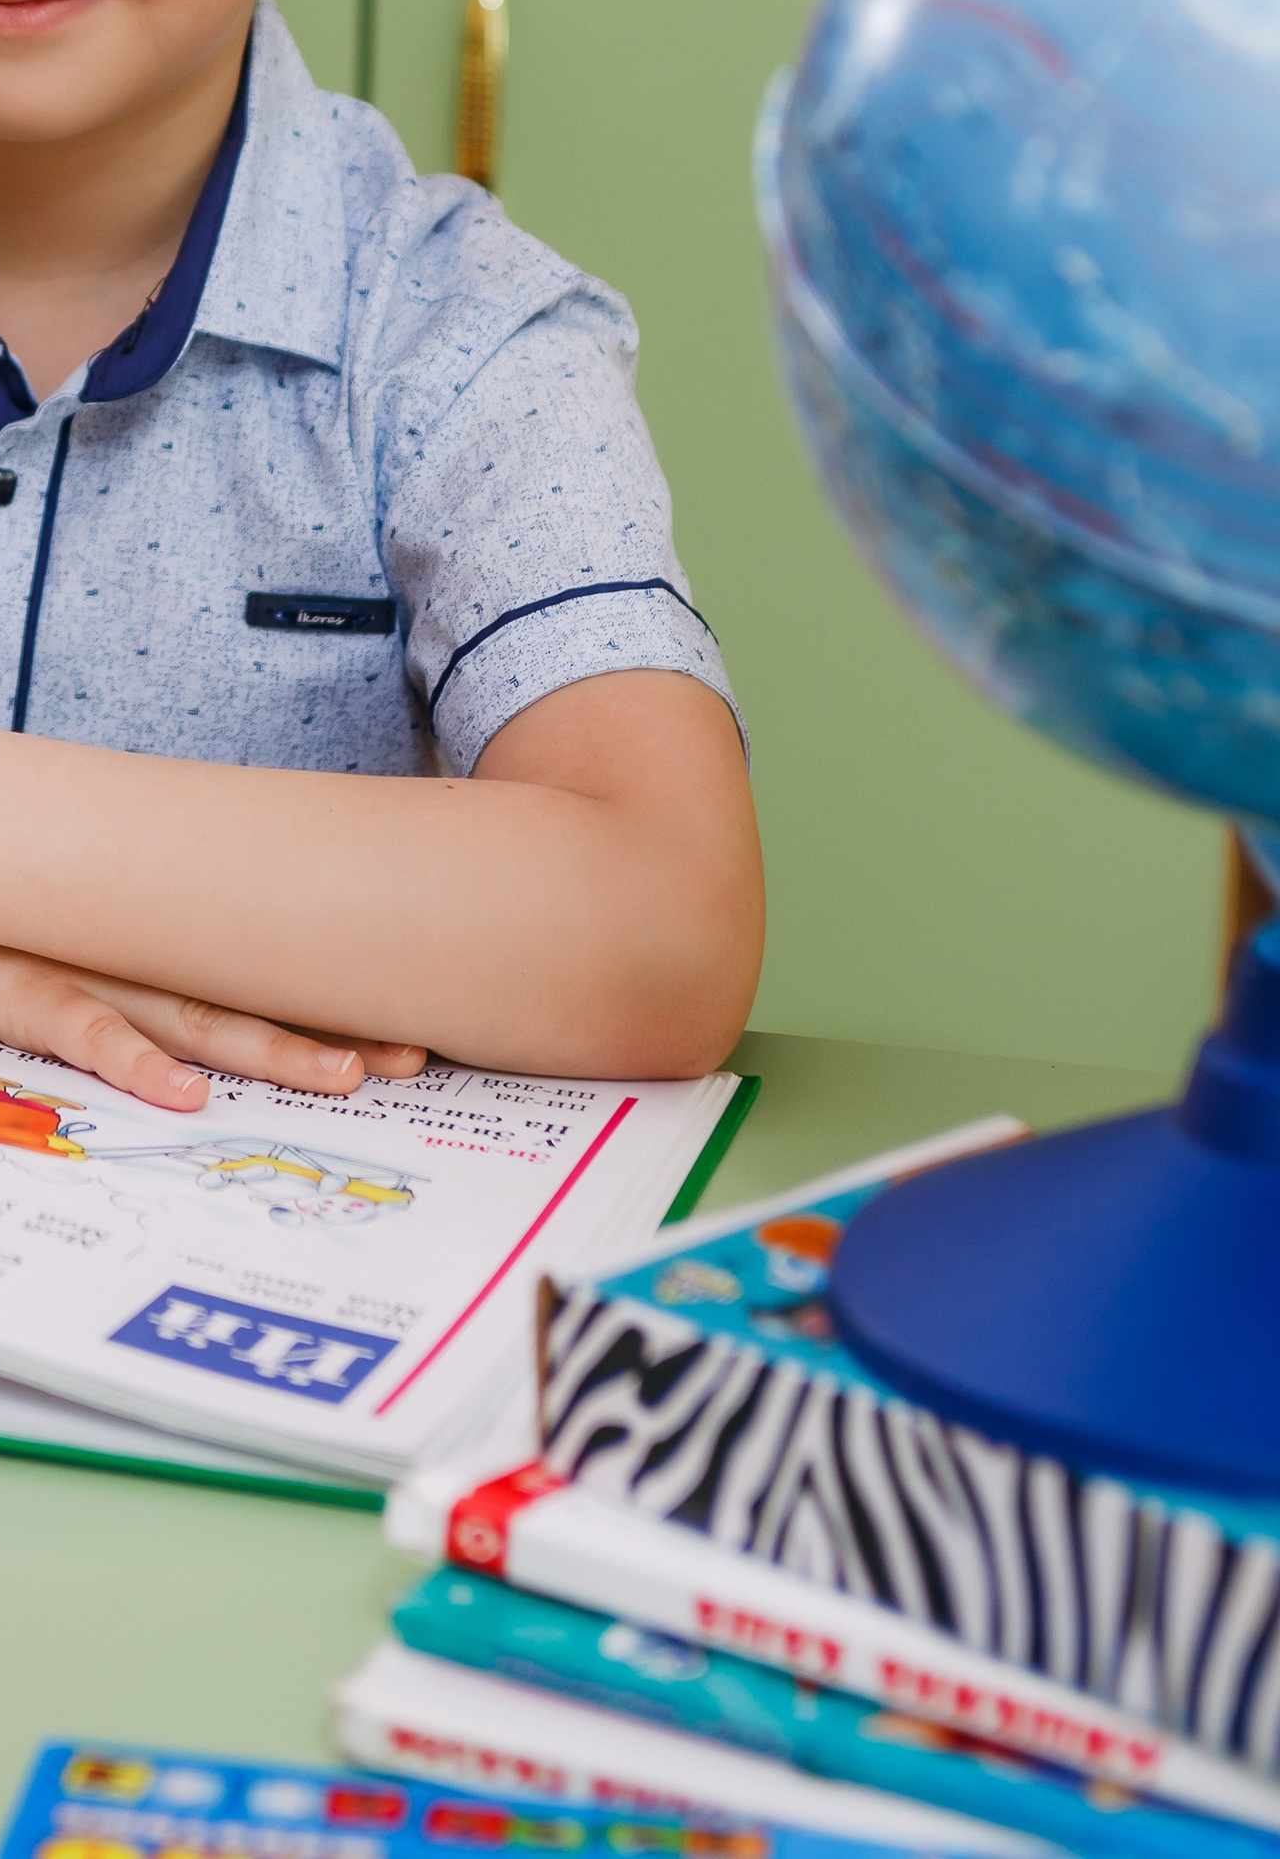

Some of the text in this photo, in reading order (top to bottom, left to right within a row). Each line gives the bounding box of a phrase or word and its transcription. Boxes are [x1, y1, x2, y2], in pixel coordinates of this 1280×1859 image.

[209, 1090, 243, 1103] У
[480, 1076, 597, 1101] пи-лой
[265, 1096, 388, 1121] сан-ки.
[368, 1098, 504, 1124] сан-ках
[494, 1092, 589, 1113] пи-ла
[405, 1117, 516, 1143] Зи-ны
[524, 1120, 572, 1136] На
[416, 1134, 551, 1166] Зи-мой.
[531, 1137, 562, 1149] У
